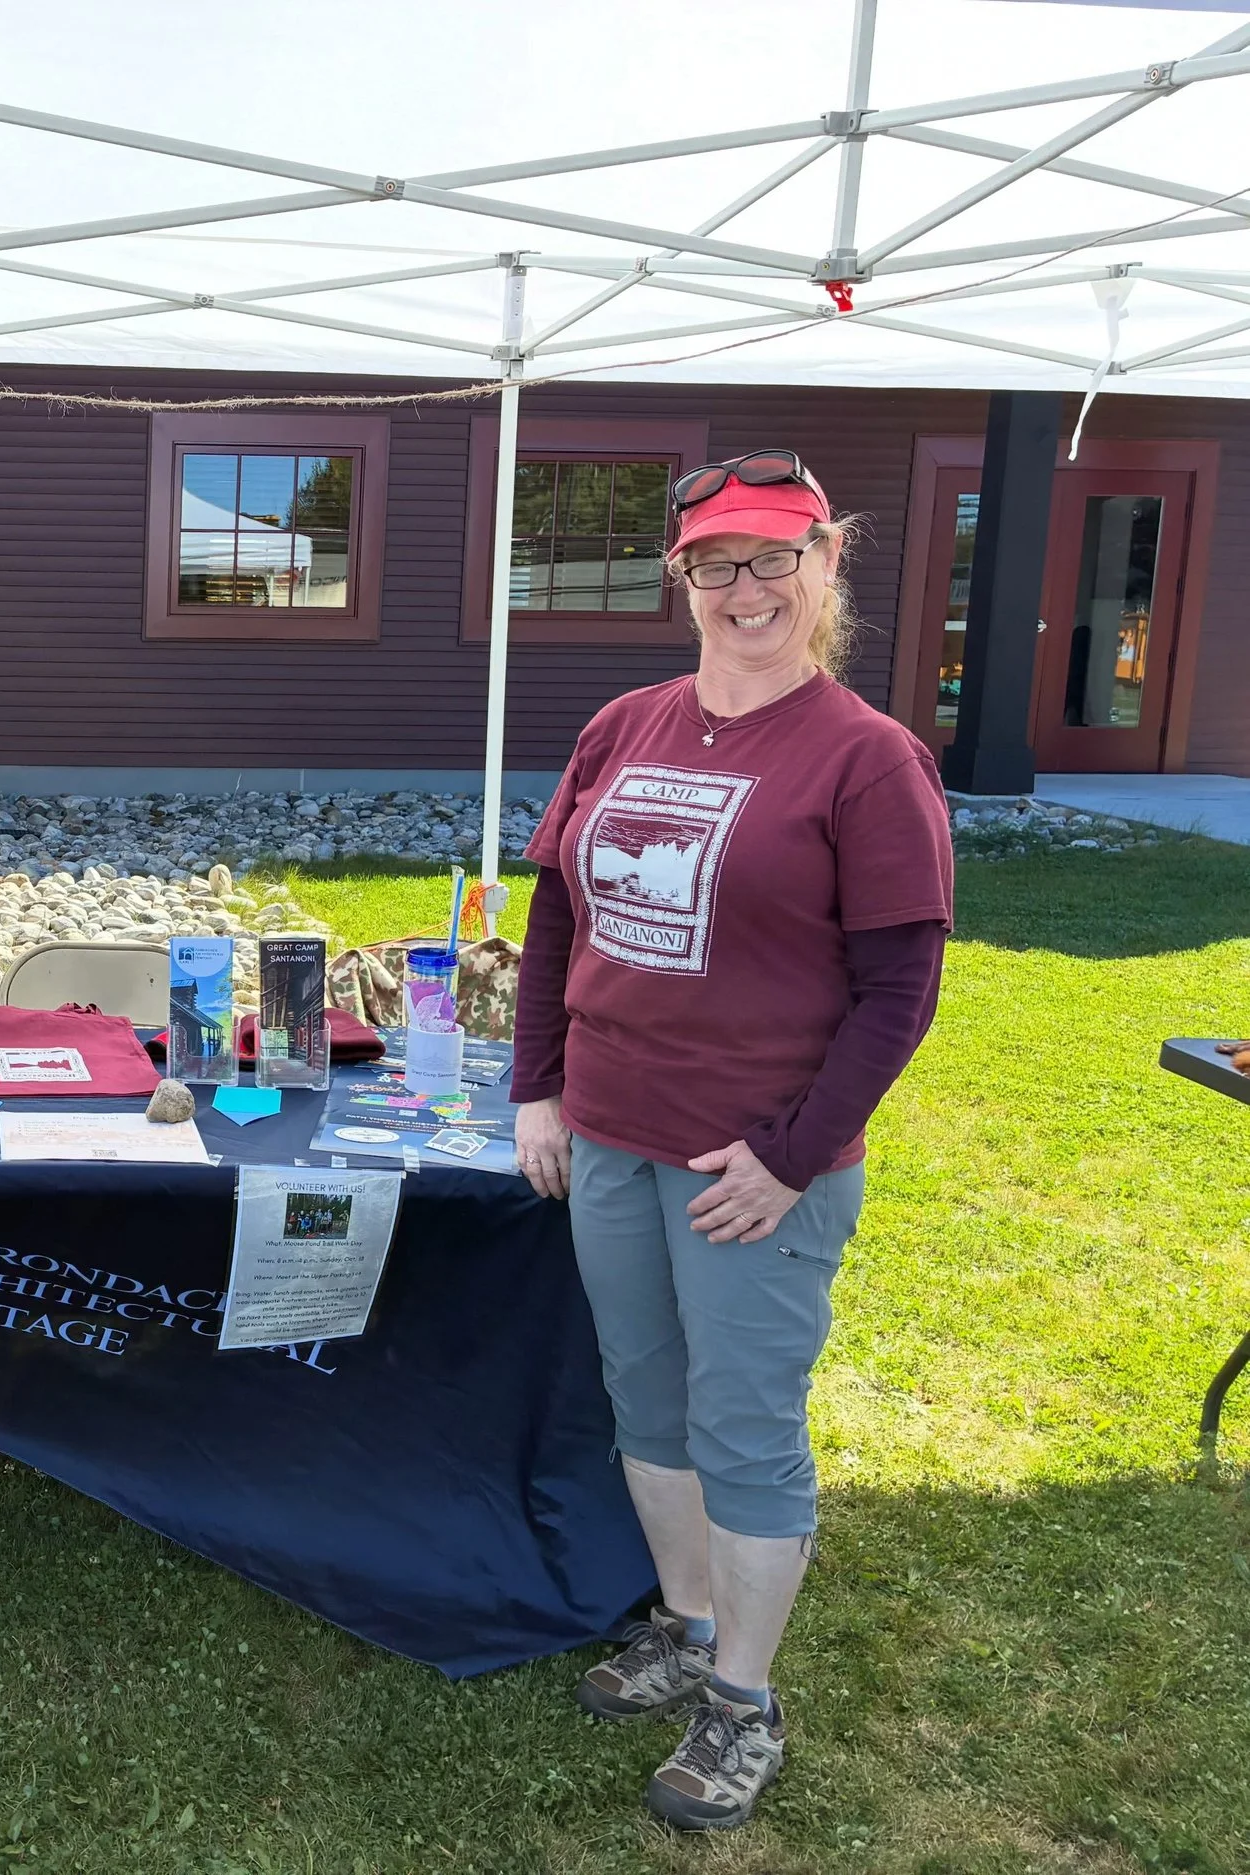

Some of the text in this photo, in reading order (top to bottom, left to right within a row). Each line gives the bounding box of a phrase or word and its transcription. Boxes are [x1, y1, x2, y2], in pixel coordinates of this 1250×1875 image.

[642, 783, 700, 800] CAMP
[599, 915, 685, 949] SANTANONI
[267, 944, 292, 952] GREAT
[270, 955, 316, 963] SANTANONI
[275, 1182, 366, 1193] VOLUNTEER WITH US!
